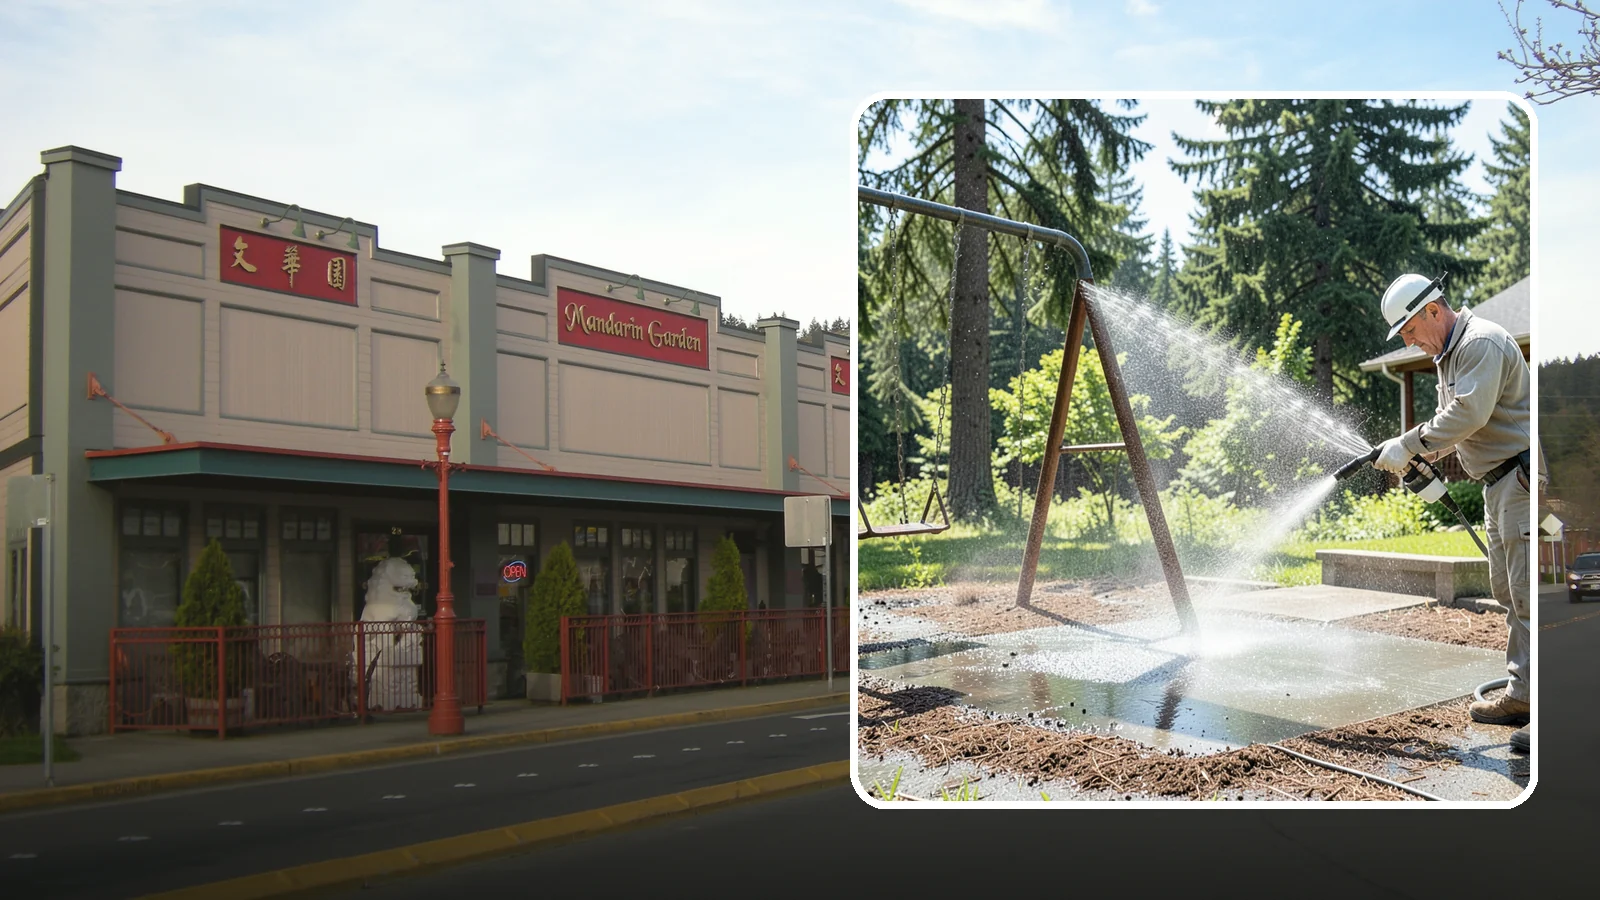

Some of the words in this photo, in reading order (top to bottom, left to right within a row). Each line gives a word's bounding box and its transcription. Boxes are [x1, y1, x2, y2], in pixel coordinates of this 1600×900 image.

[231, 236, 347, 291] 文華園
[565, 302, 644, 341] Mandarin
[648, 320, 701, 352] Garden
[503, 565, 527, 578] OPEN
